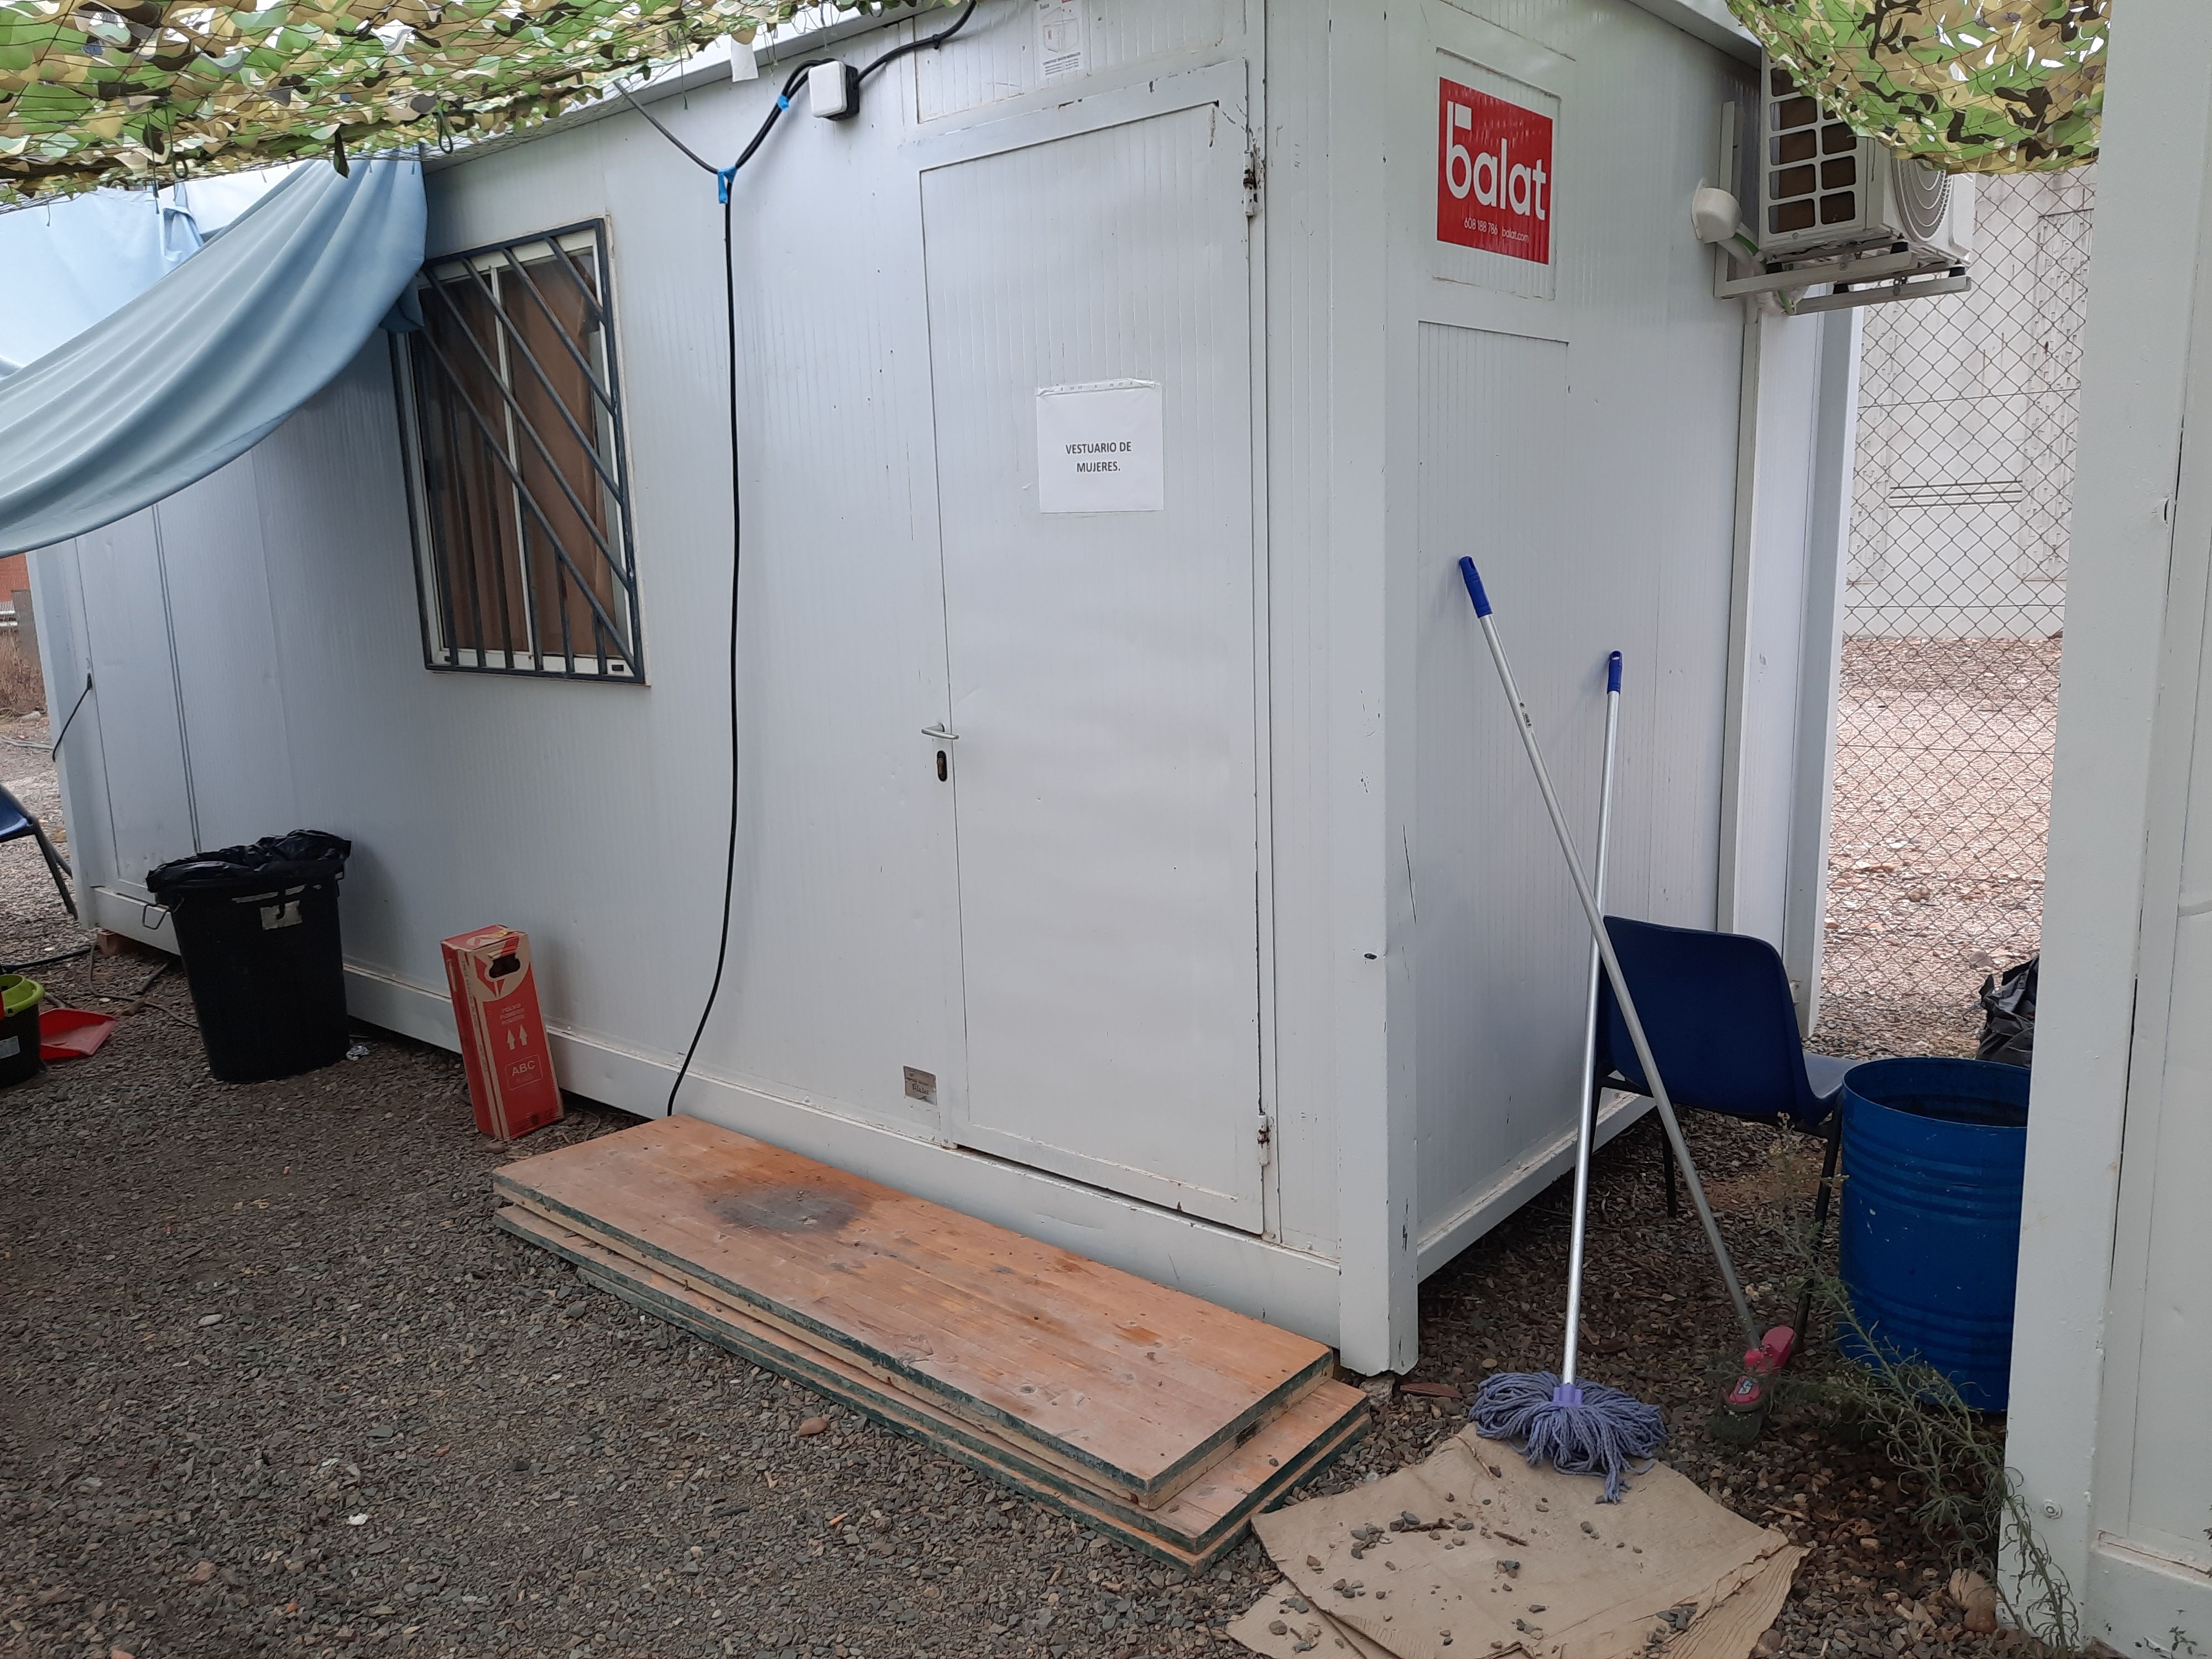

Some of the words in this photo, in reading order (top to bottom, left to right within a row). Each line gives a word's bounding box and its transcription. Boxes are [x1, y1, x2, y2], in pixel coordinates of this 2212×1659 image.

[1447, 101, 1546, 221] balat
[1464, 217, 1476, 230] 608
[1066, 442, 1117, 454] VESTUARIO
[1119, 441, 1131, 452] DE
[1077, 461, 1120, 473] MUJERES.
[512, 1060, 536, 1076] ABC
